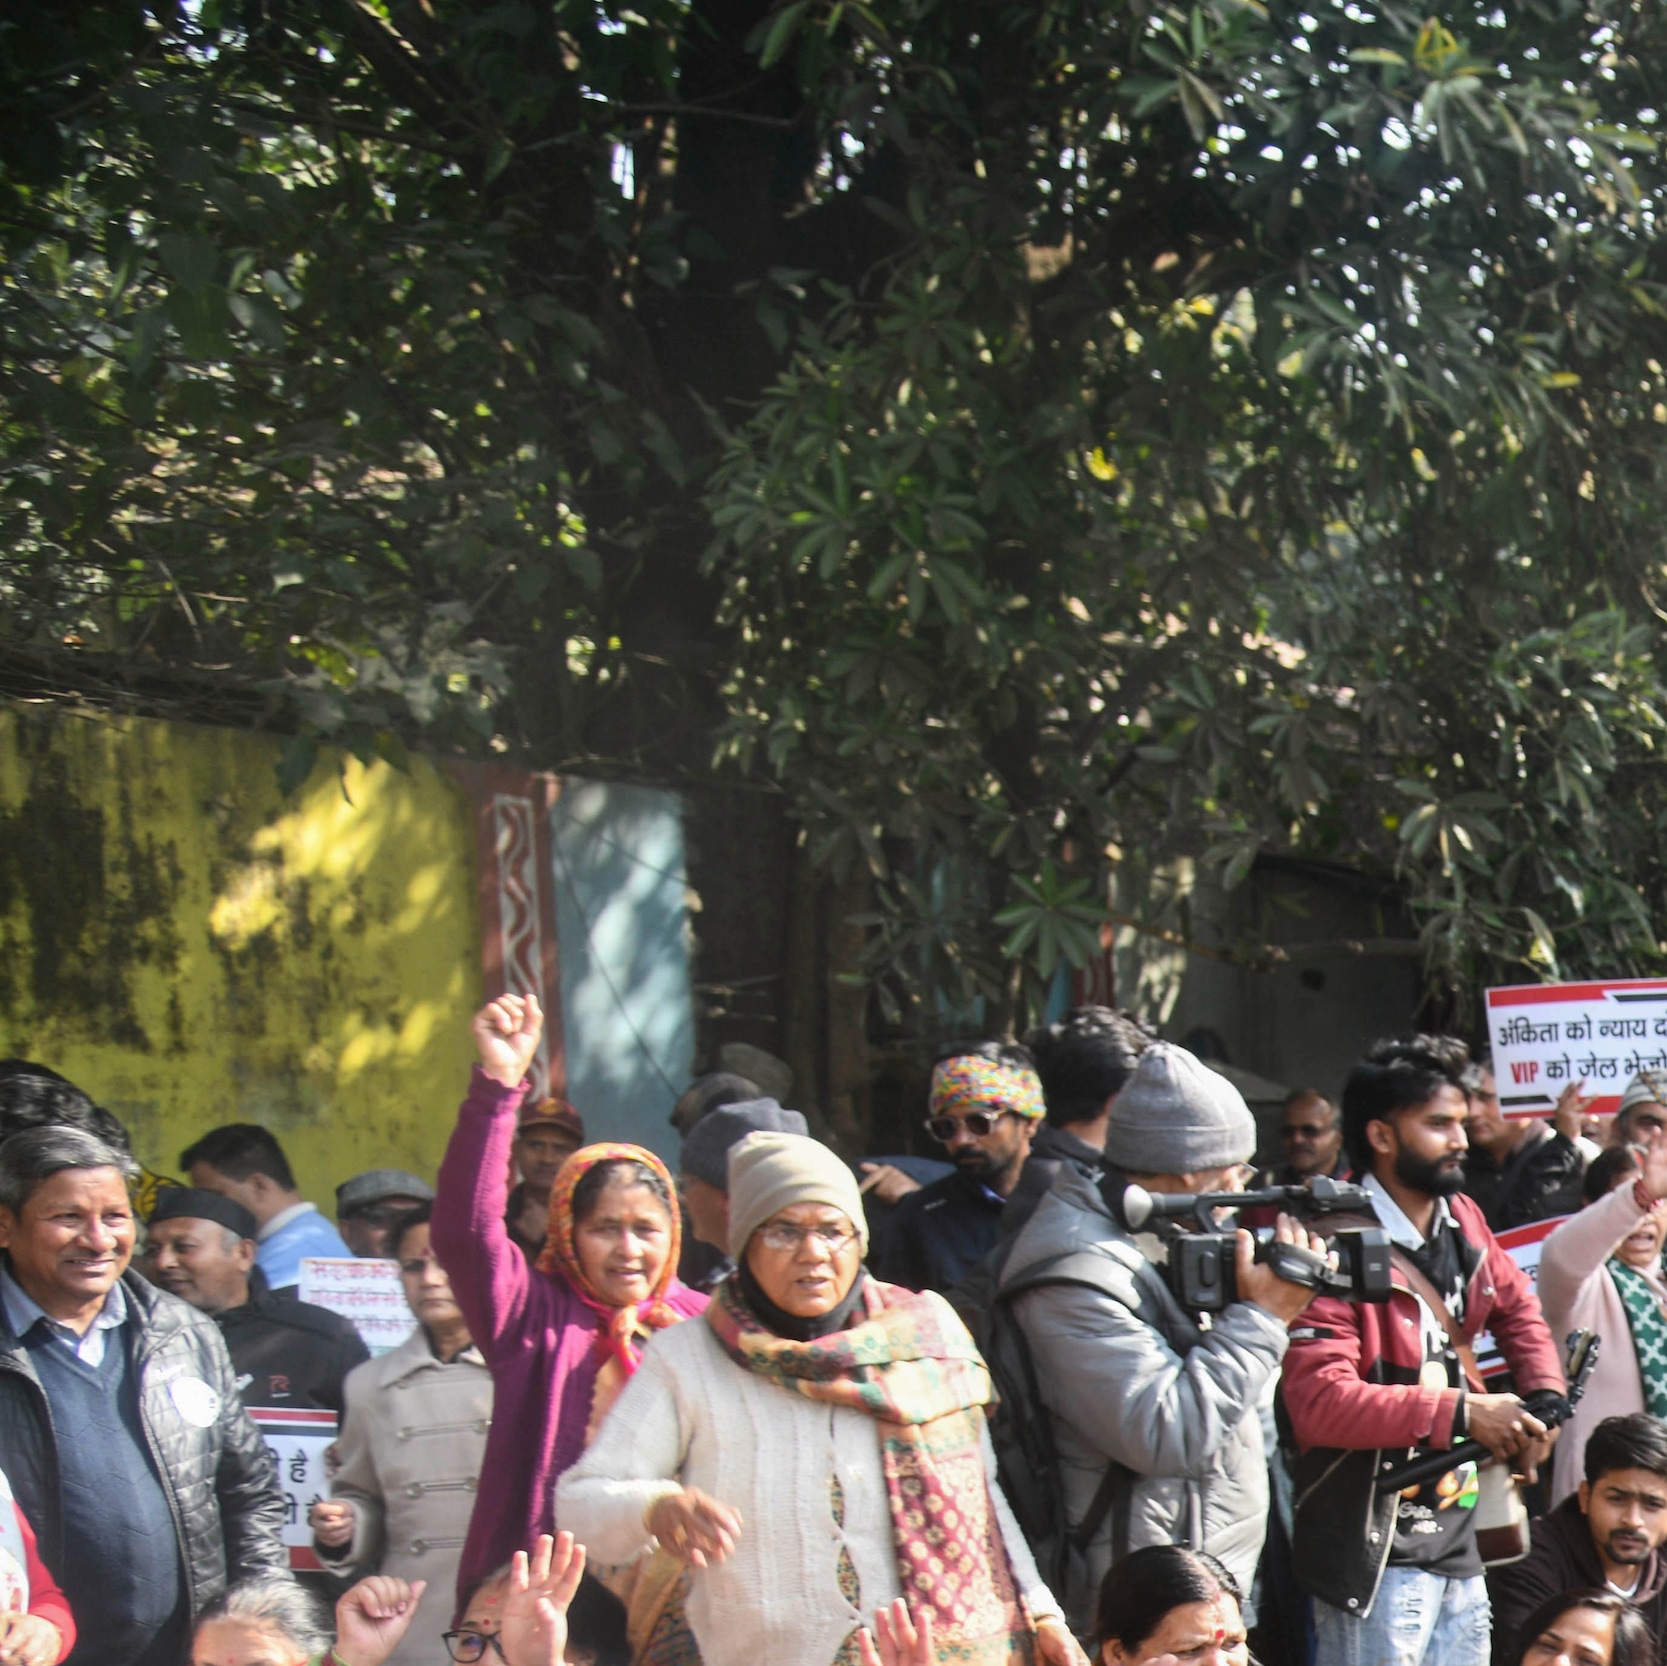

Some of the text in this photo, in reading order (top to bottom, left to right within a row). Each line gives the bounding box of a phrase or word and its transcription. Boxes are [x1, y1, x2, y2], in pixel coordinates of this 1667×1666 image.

[1499, 1016, 1559, 1046] अंकिता
[1566, 1013, 1592, 1040] को
[1600, 1018, 1646, 1038] न्याय
[1511, 1061, 1539, 1084] VIP
[1546, 1053, 1571, 1079] को
[1578, 1051, 1618, 1080] जेल
